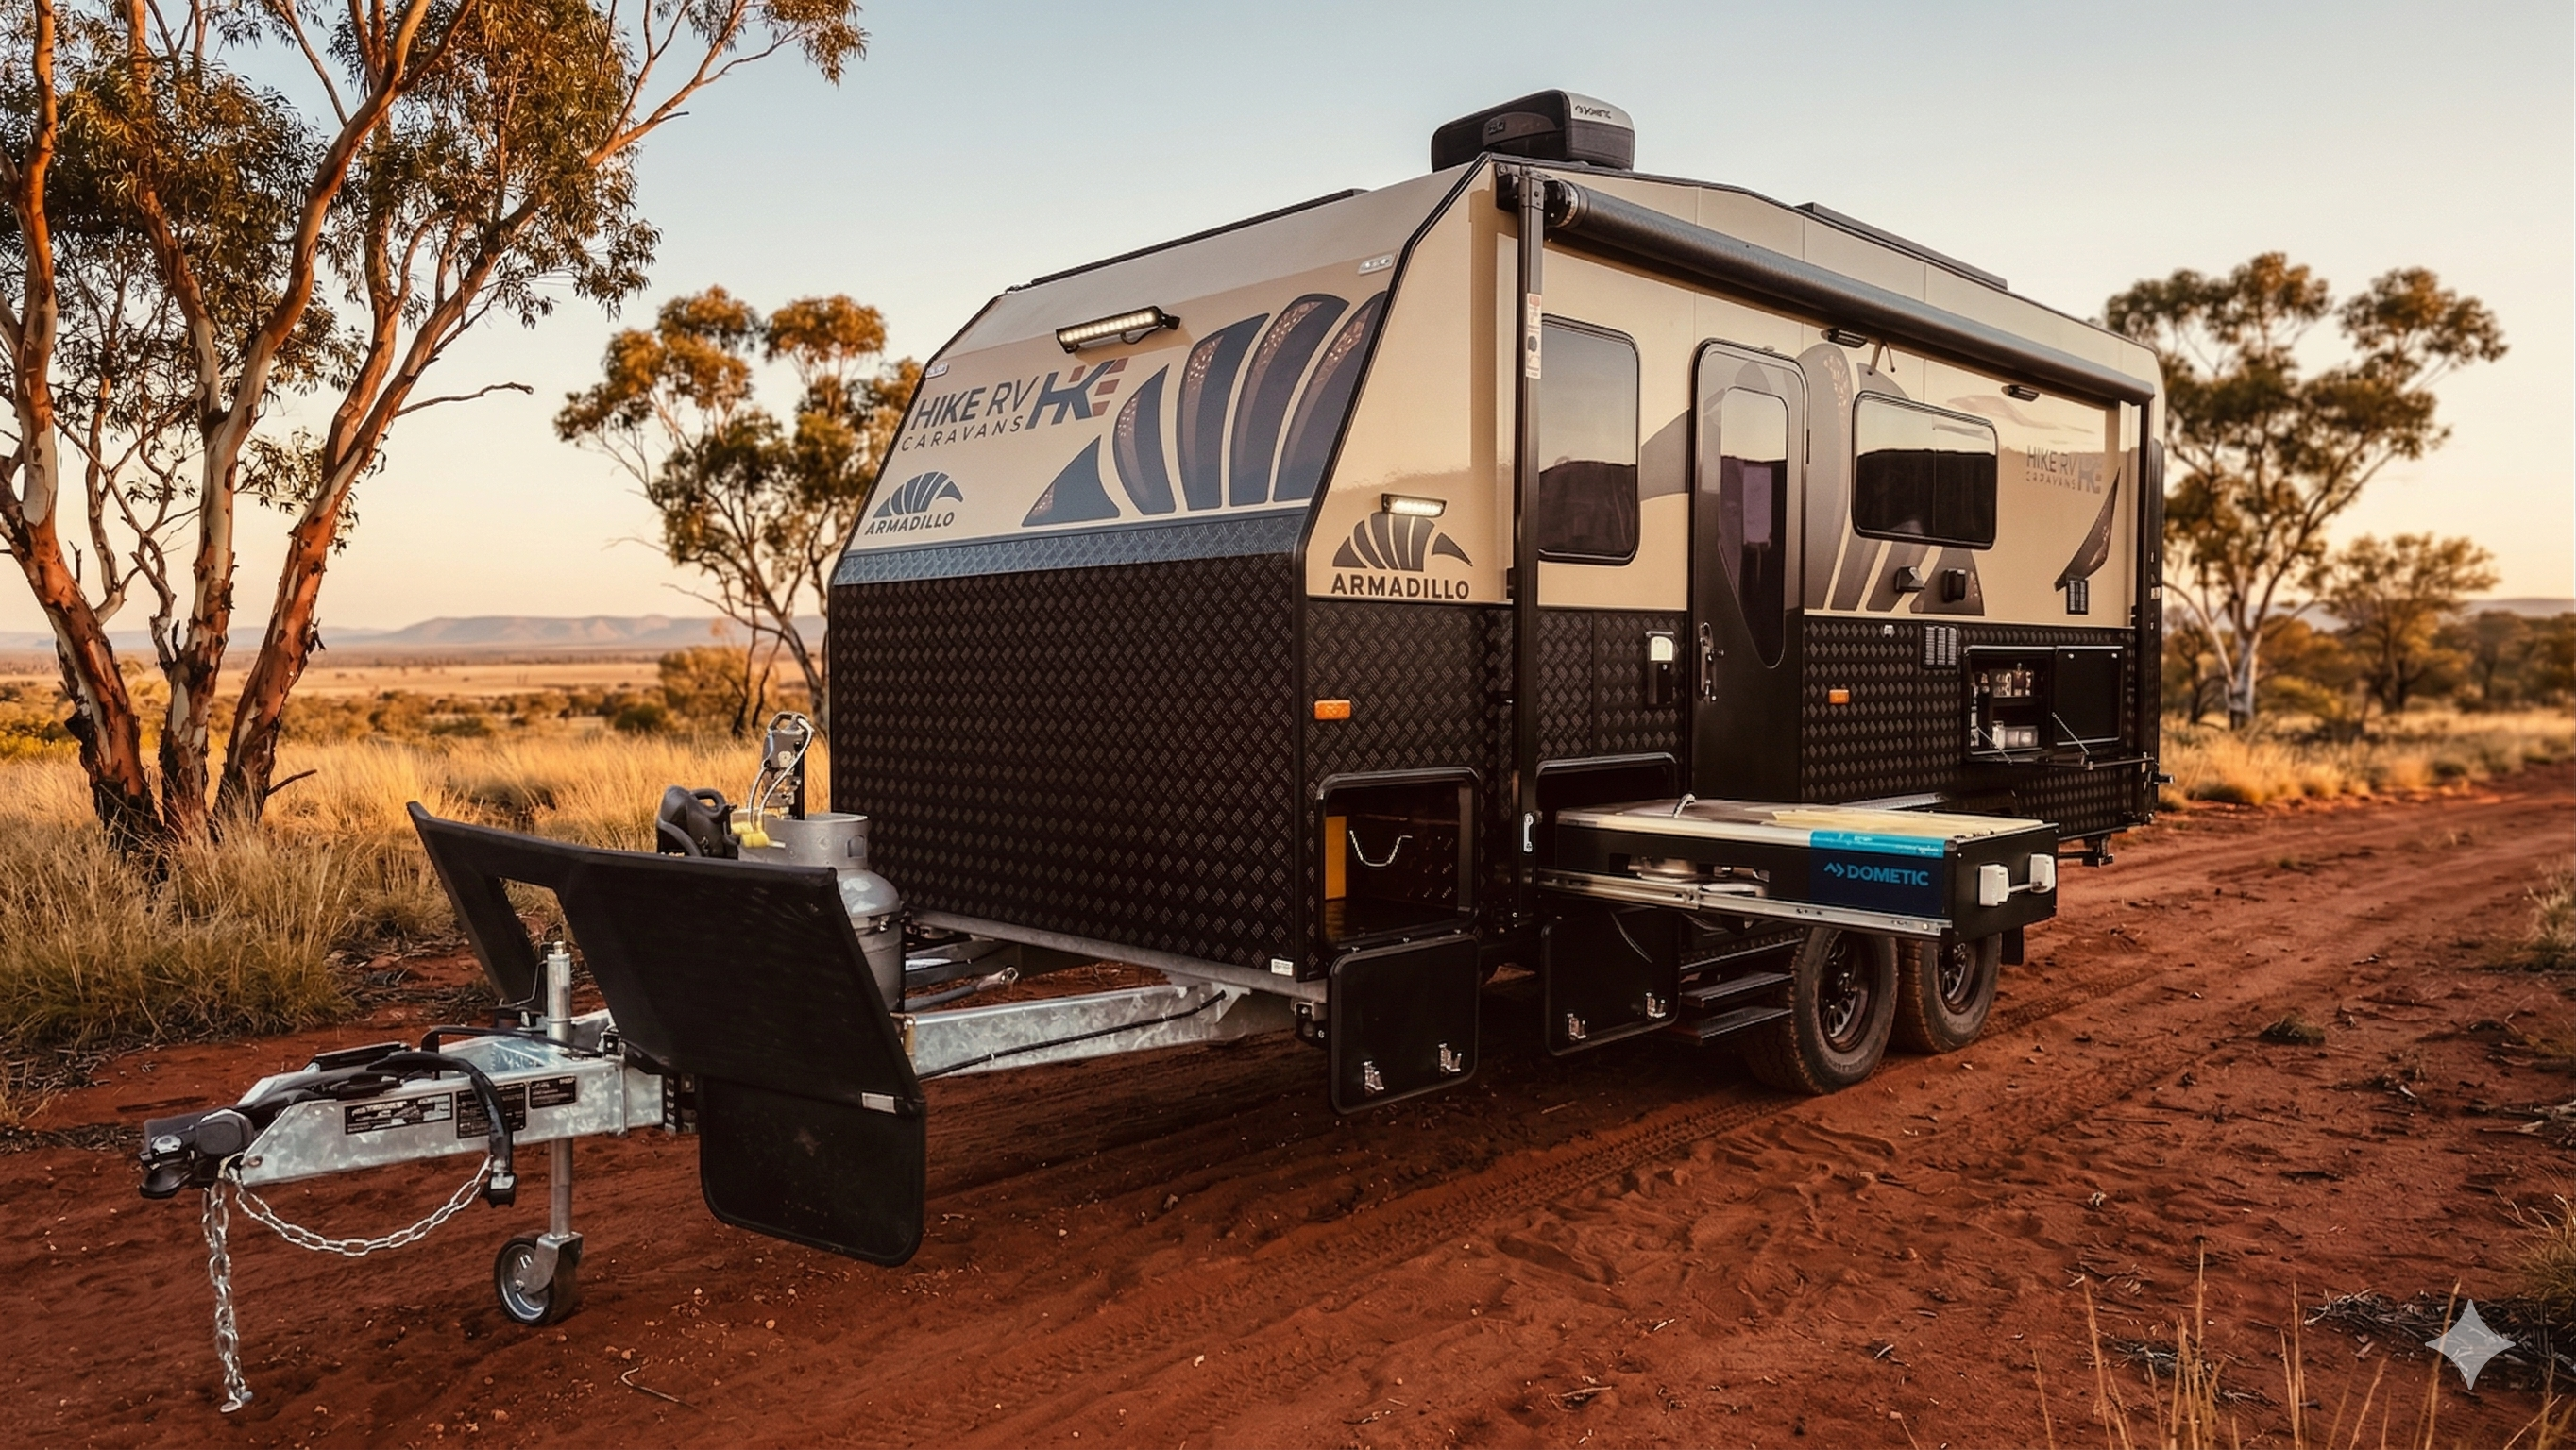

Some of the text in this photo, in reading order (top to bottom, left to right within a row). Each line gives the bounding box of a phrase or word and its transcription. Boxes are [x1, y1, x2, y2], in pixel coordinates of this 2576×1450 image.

[909, 386, 987, 431] HIKE
[986, 375, 1041, 417] RV
[901, 415, 1024, 452] CARAVANS
[2026, 445, 2058, 473] HIKE
[2059, 452, 2078, 476] RV
[864, 511, 955, 536] ARMADILLO
[1330, 572, 1469, 600] ARMADILLO
[1846, 864, 1929, 886] DOMETIC
